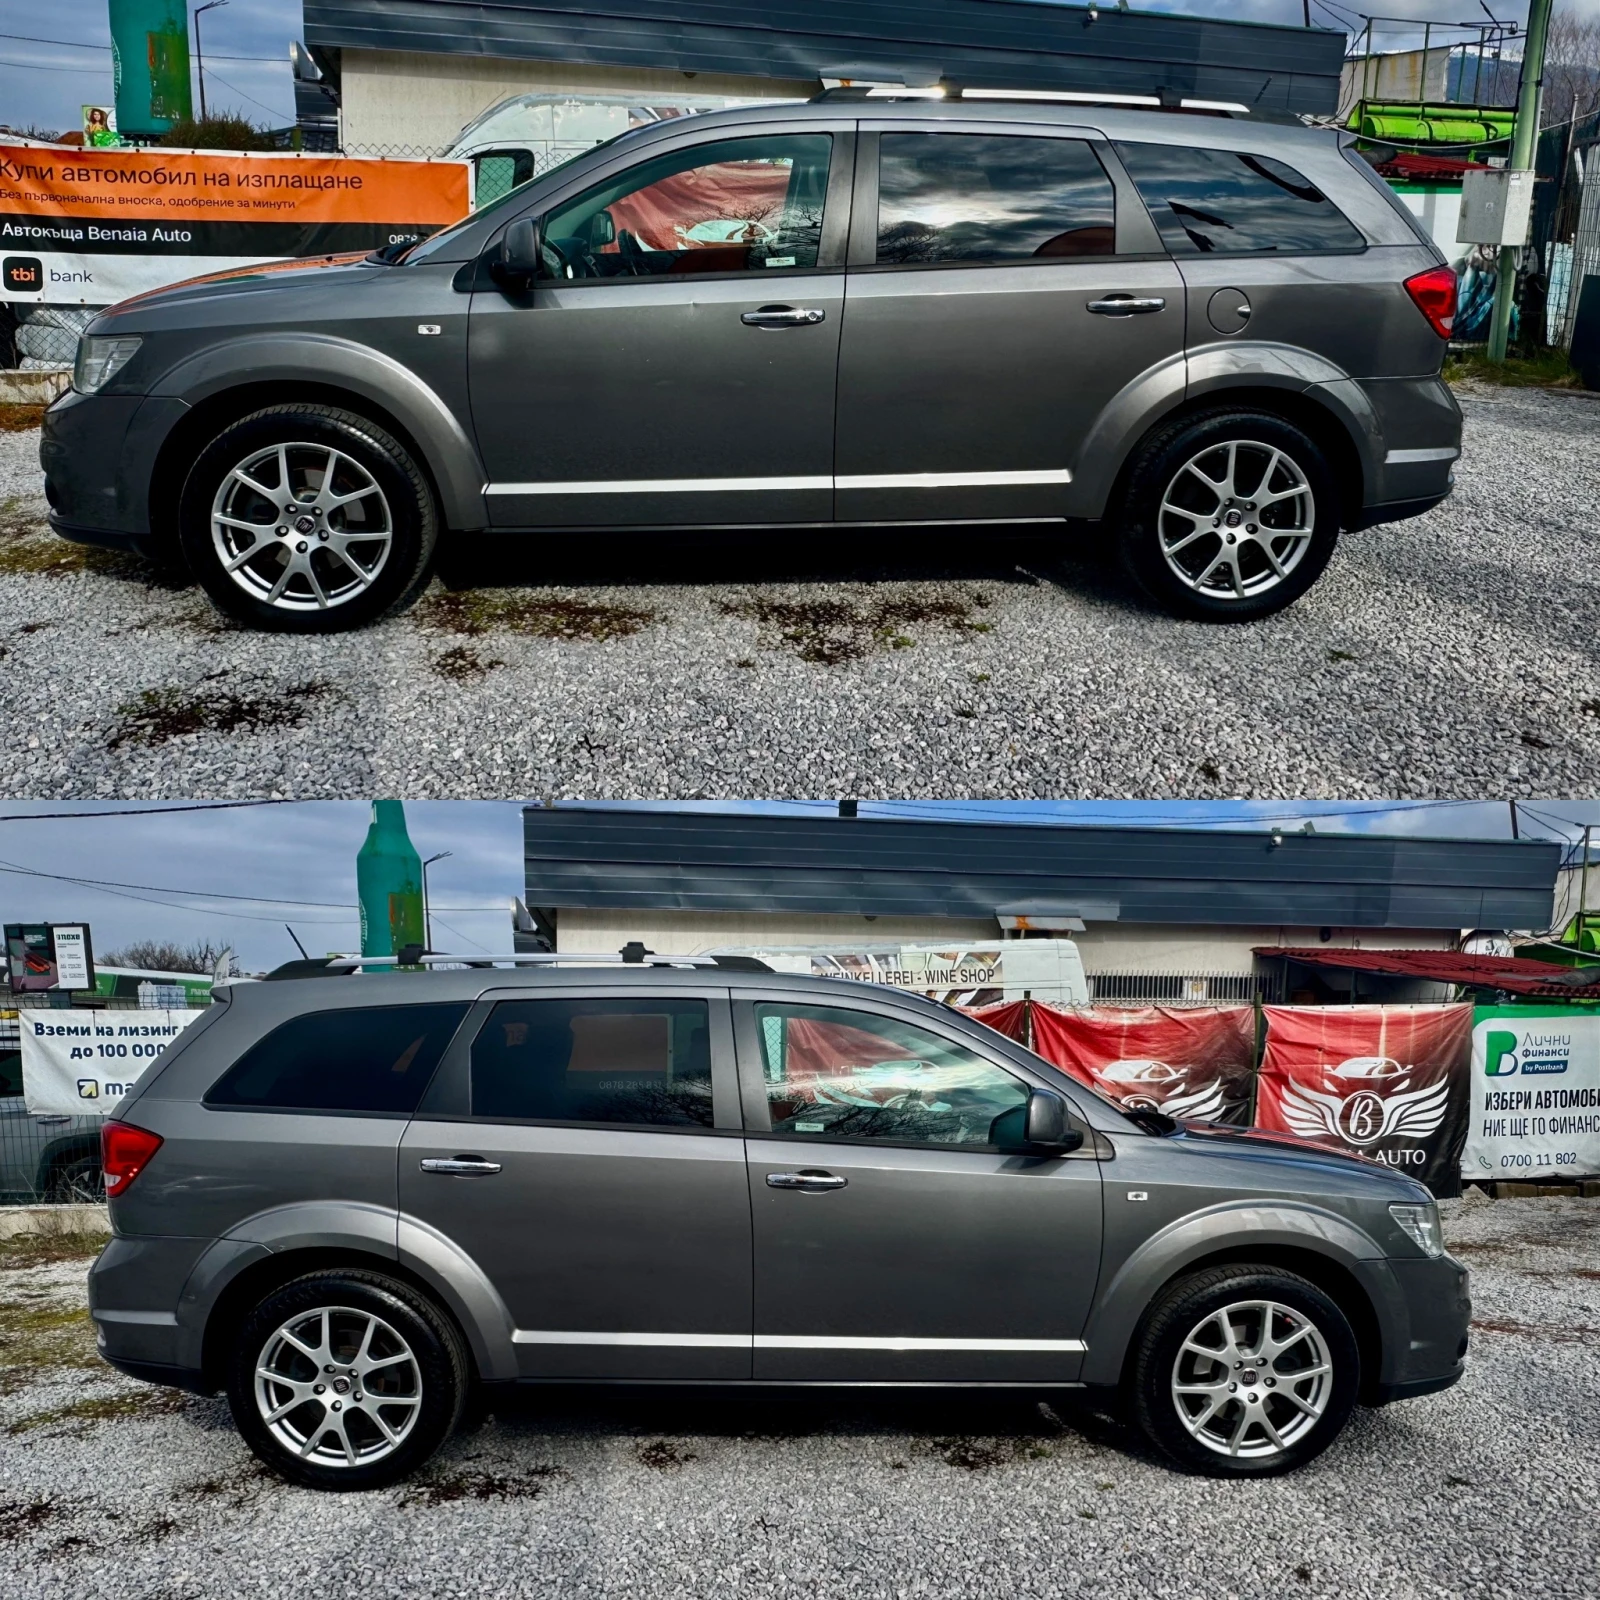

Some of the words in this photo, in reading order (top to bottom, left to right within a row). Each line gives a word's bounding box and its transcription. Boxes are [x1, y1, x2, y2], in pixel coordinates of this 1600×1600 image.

[0, 158, 54, 182] Купи
[62, 166, 197, 186] автомобил
[204, 172, 230, 187] на
[237, 174, 363, 191] изплащане
[0, 188, 22, 200] Без
[25, 192, 115, 205] първоначална
[119, 196, 166, 207] вноска,
[169, 198, 235, 208] одобрение
[253, 201, 296, 210] минути
[2, 222, 83, 241] Автокъща
[88, 226, 147, 241] Benaia
[152, 228, 192, 242] Auto
[11, 268, 35, 282] tbi
[50, 269, 94, 283] bank
[925, 969, 957, 984] WINE
[961, 968, 995, 983] SHOP
[34, 1022, 91, 1036] Вземи
[95, 1025, 114, 1036] на
[117, 1025, 178, 1037] лизинг
[1522, 1032, 1571, 1047] Лични
[70, 1046, 94, 1059] до
[97, 1044, 128, 1057] 100
[1522, 1048, 1570, 1059] финанси
[1485, 1090, 1532, 1111] ИЗБЕРИ
[1483, 1119, 1507, 1137] НИЕ
[1510, 1118, 1529, 1139] ЩЕ
[1532, 1117, 1546, 1135] ГО
[1375, 1149, 1426, 1165] AUTO
[1501, 1154, 1532, 1168] 0700
[1536, 1154, 1552, 1166] 11
[1555, 1152, 1577, 1165] 802
